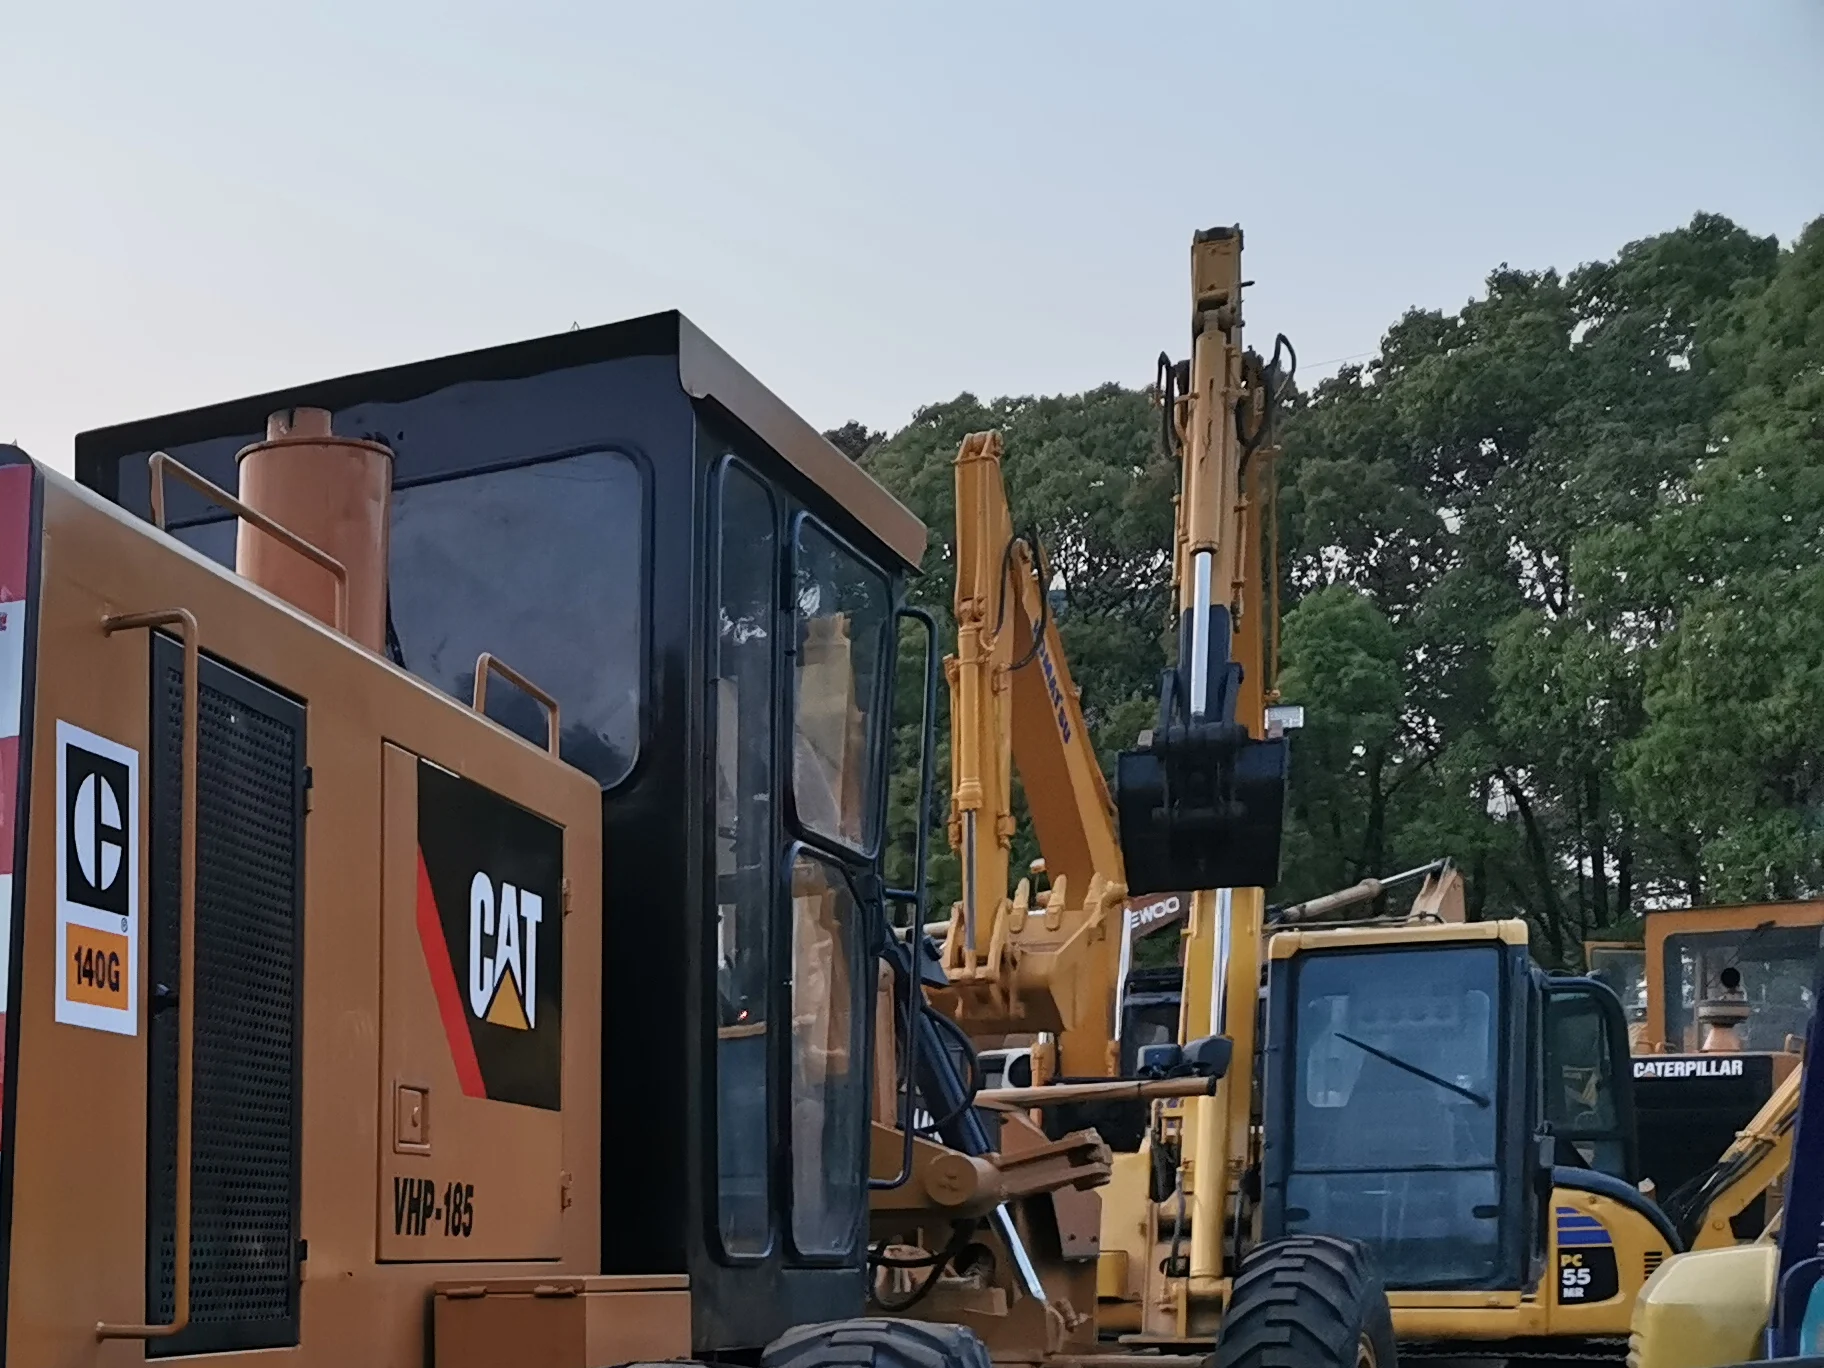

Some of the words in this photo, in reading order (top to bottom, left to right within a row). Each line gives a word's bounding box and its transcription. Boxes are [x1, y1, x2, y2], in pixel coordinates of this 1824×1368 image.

[469, 871, 543, 1030] CAT
[74, 945, 121, 993] 140G
[1633, 1059, 1743, 1078] CATERPILLAR
[393, 1176, 474, 1238] VHP-185
[1560, 1253, 1583, 1267] PC
[1561, 1268, 1591, 1286] 55
